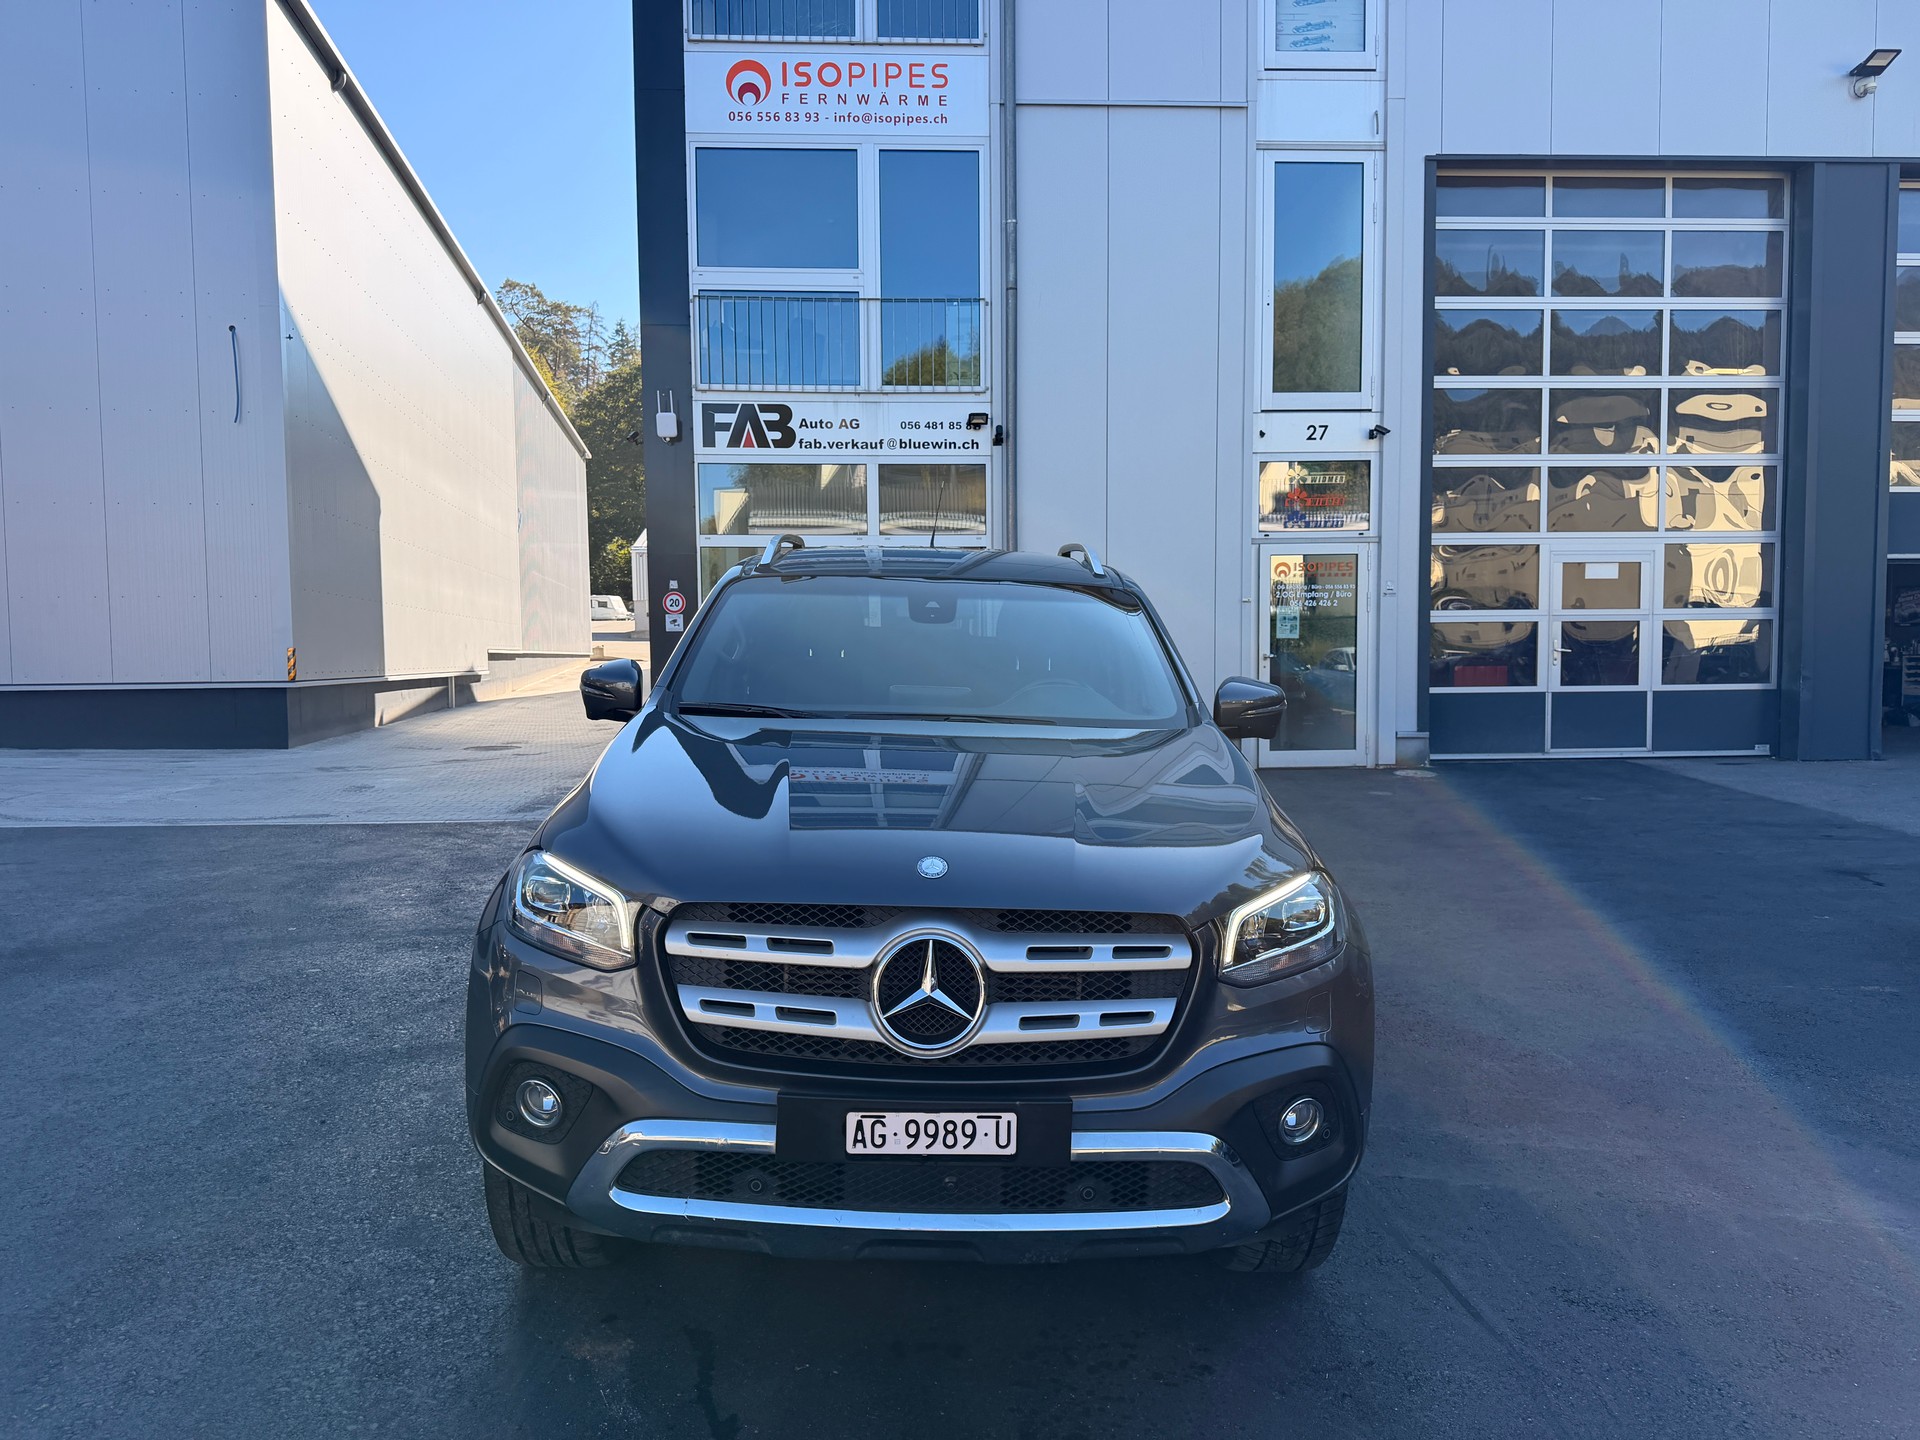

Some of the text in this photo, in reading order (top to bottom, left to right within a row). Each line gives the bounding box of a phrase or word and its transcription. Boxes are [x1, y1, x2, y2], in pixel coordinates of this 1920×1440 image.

[781, 61, 949, 89] ISOPIPES
[781, 92, 948, 107] FERNWÄRME
[728, 111, 753, 122] 056
[756, 111, 781, 122] 556
[784, 112, 800, 123] 83
[804, 112, 820, 123] 93
[833, 112, 948, 126] info@isopipes.ch
[701, 403, 797, 448] FAB
[798, 418, 860, 430] Auto AG
[900, 420, 921, 430] 056
[924, 421, 944, 430] 481
[948, 421, 962, 430] 85
[1306, 424, 1329, 441] 27
[798, 437, 980, 450] fab.verkauf@bluewin.ch
[1293, 561, 1354, 572] ISOPIPES
[1296, 591, 1329, 599] Empfang
[1336, 590, 1352, 598] Büro
[669, 598, 680, 607] 20
[852, 1119, 887, 1149] AG
[904, 1119, 977, 1150] 9989
[995, 1119, 1012, 1150] U
